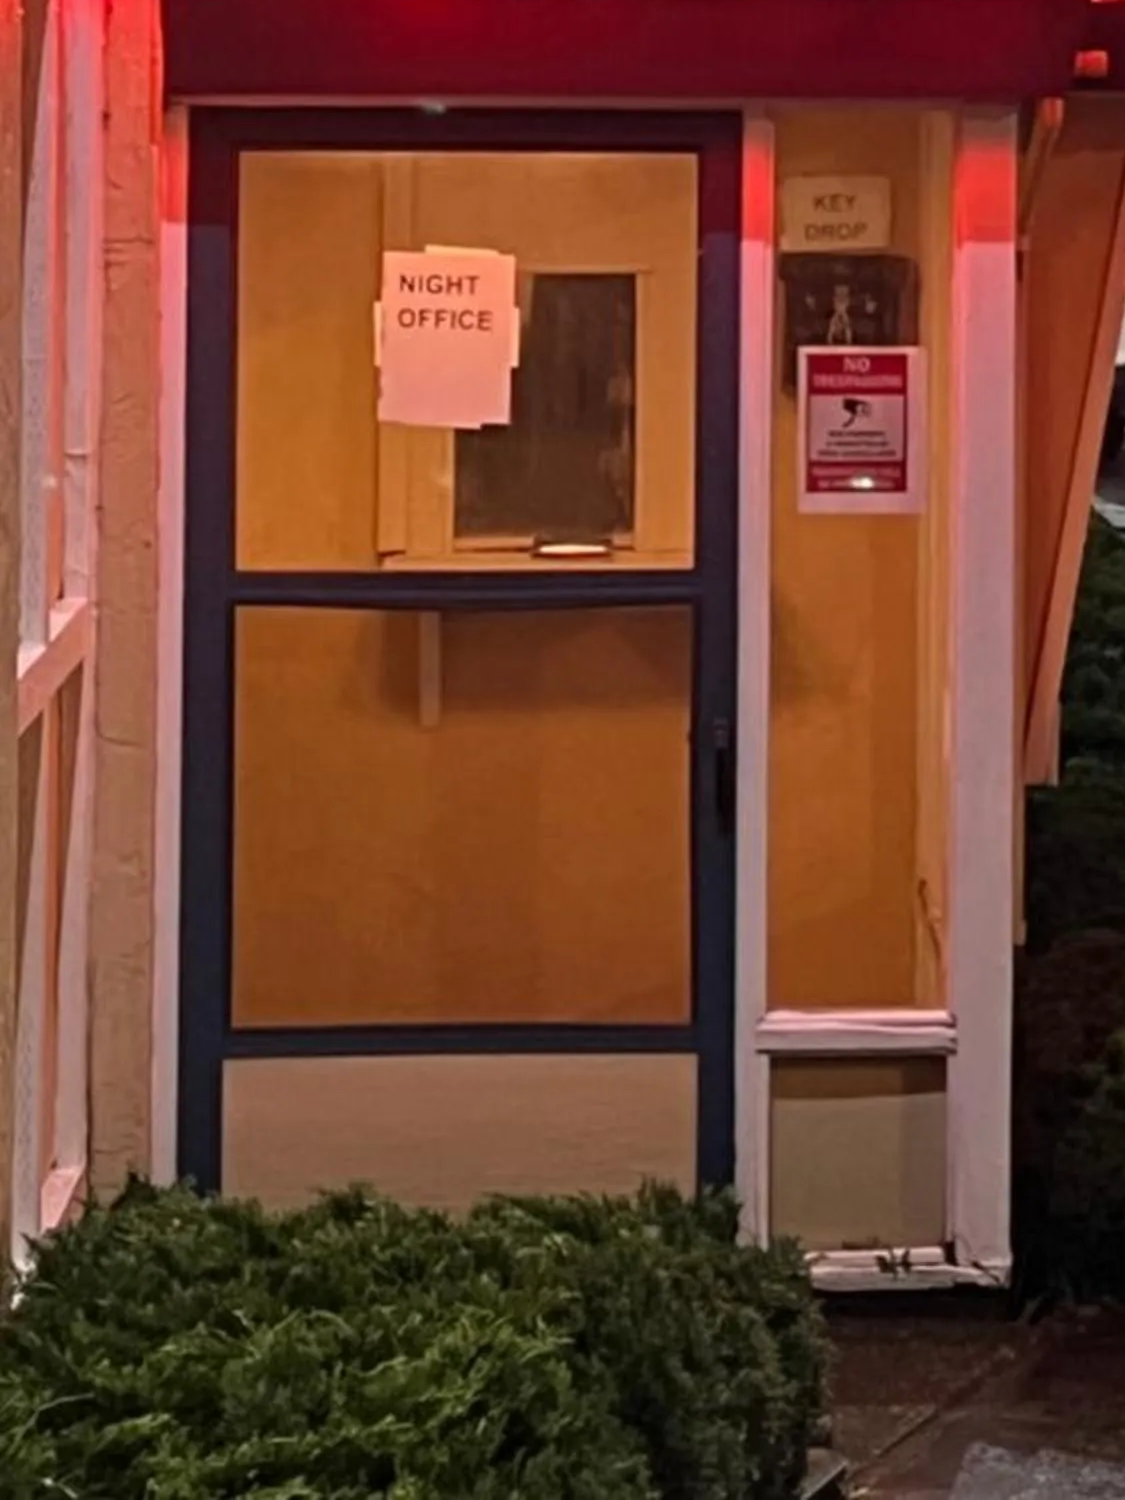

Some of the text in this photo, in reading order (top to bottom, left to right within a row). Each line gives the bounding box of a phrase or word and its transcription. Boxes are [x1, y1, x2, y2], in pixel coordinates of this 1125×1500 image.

[812, 193, 855, 213] KEY
[804, 221, 868, 242] DROP
[399, 274, 480, 295] NIGHT
[397, 307, 494, 331] OFFICE
[842, 356, 872, 373] NO
